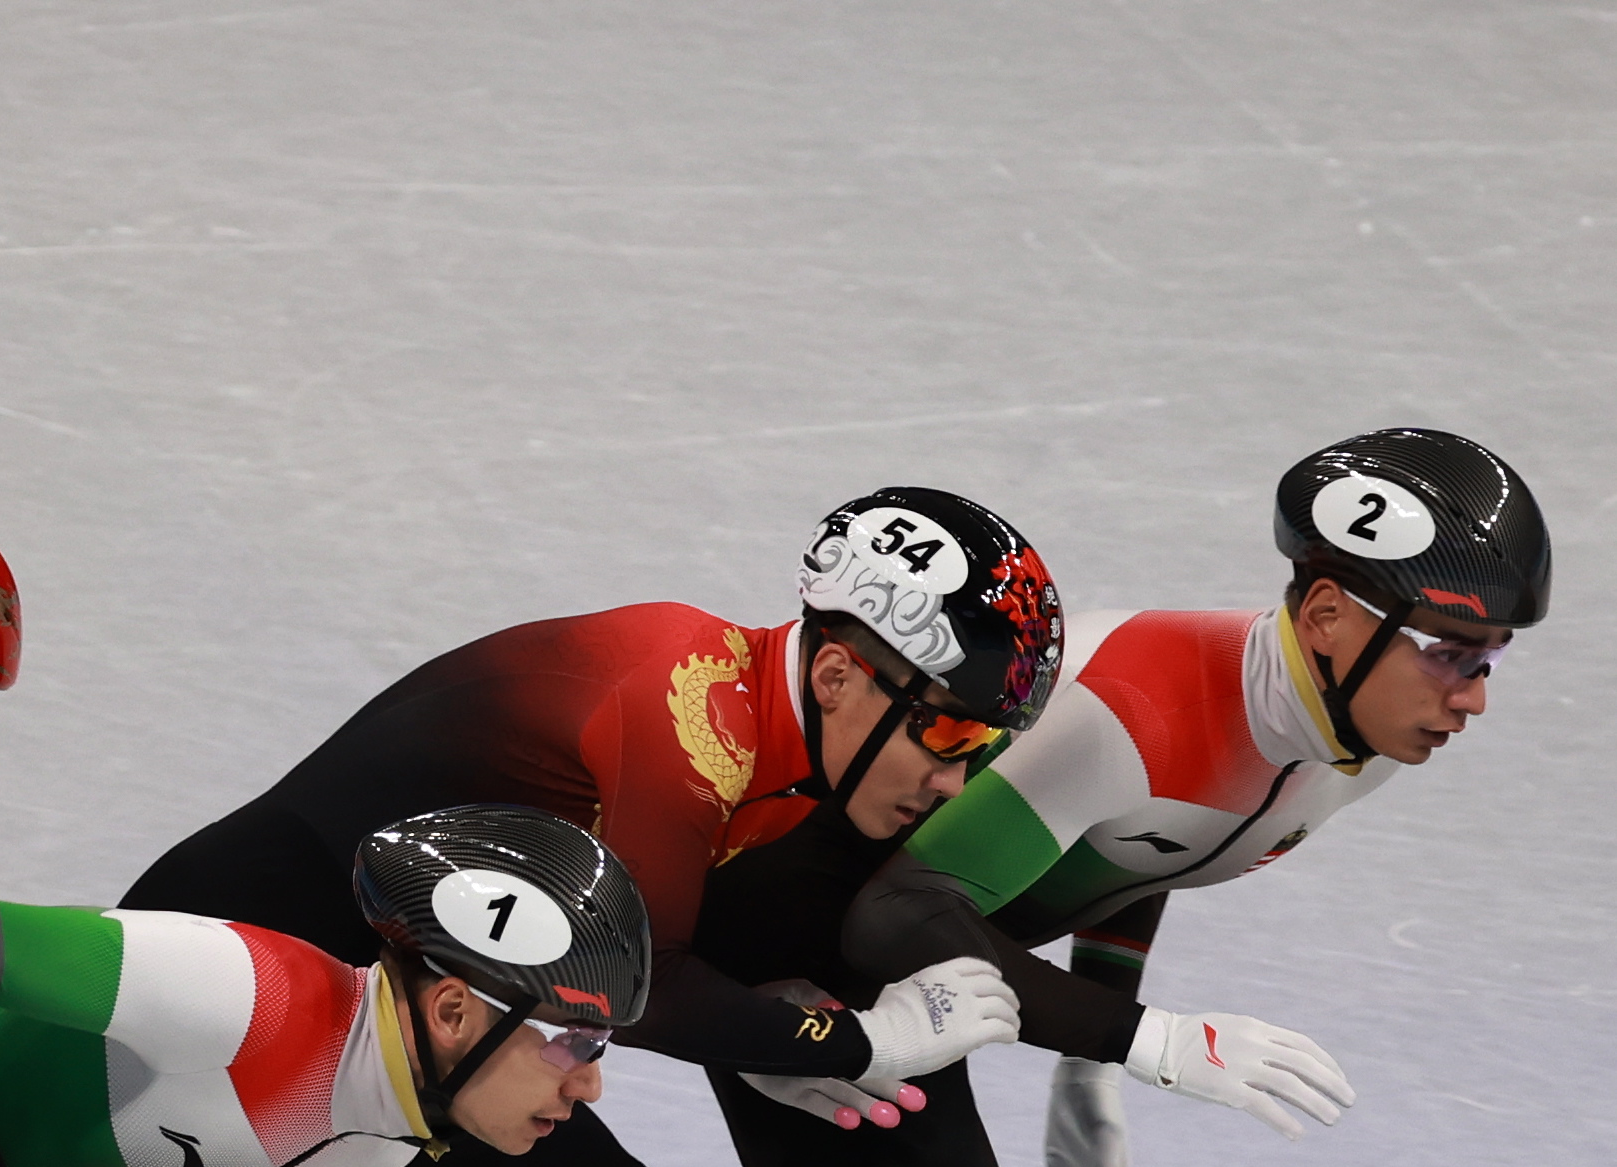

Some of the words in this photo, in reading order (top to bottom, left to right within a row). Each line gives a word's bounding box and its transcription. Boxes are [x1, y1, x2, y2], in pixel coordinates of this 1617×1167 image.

[1347, 493, 1387, 542] 2
[871, 517, 945, 574] 54
[486, 893, 518, 942] 1
